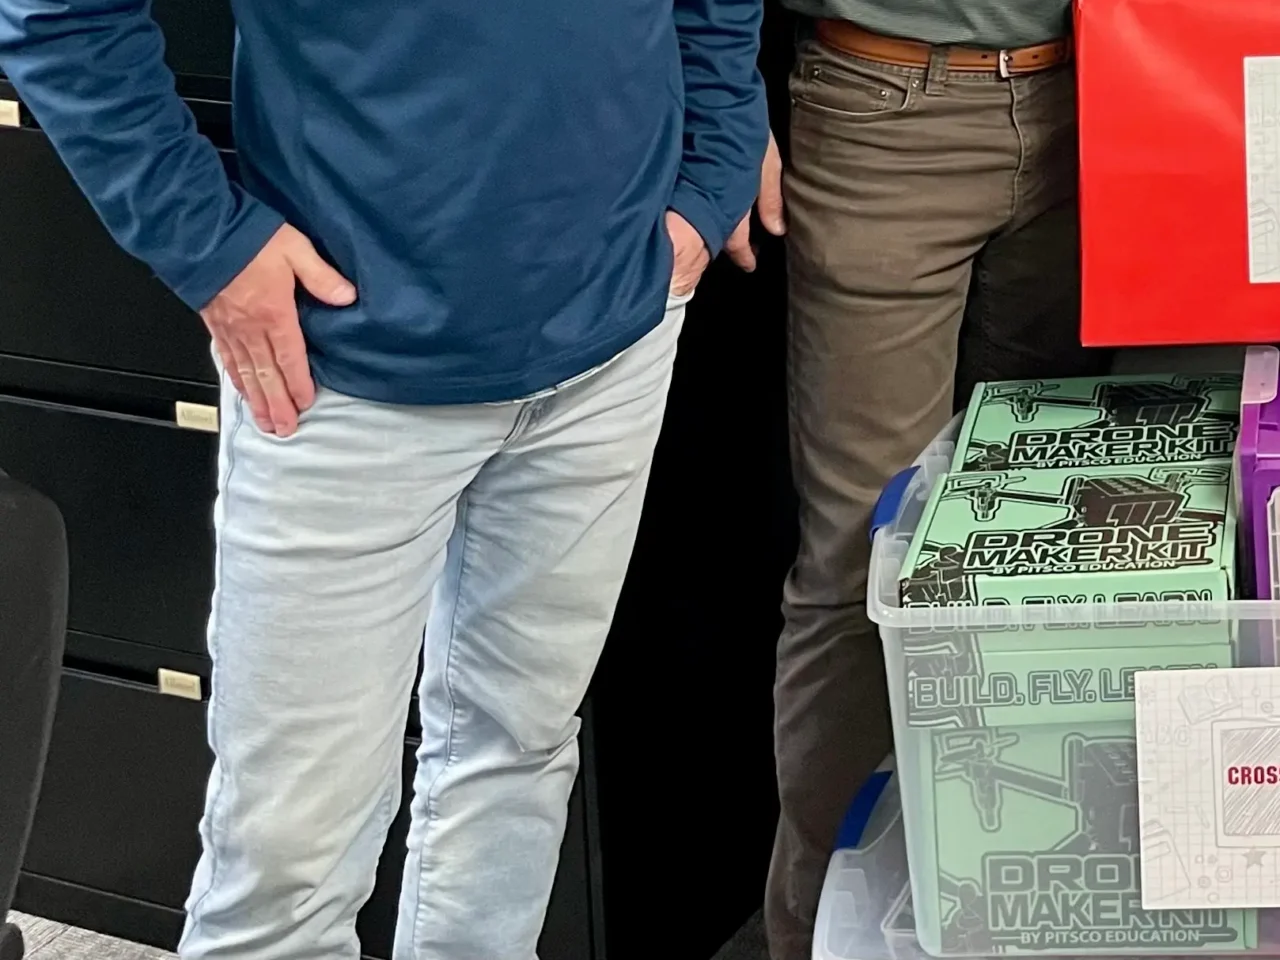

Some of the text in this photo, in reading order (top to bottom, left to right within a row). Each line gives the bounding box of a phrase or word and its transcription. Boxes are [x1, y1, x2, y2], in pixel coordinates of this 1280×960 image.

[1012, 421, 1234, 447] DRONE
[1009, 439, 1231, 464] MAKER KIT
[1058, 458, 1112, 467] PITSCO
[1114, 453, 1202, 465] EDUCATION
[970, 521, 1214, 550] DRONE
[963, 541, 1206, 569] MAKER KIT
[992, 560, 1176, 574] BY PITSCO EDUCATION
[914, 672, 1025, 709] BUILD.
[1028, 669, 1096, 705] FLY.
[985, 854, 1141, 892] DRO
[1021, 929, 1200, 944] BY PITSCO EDUCATION
